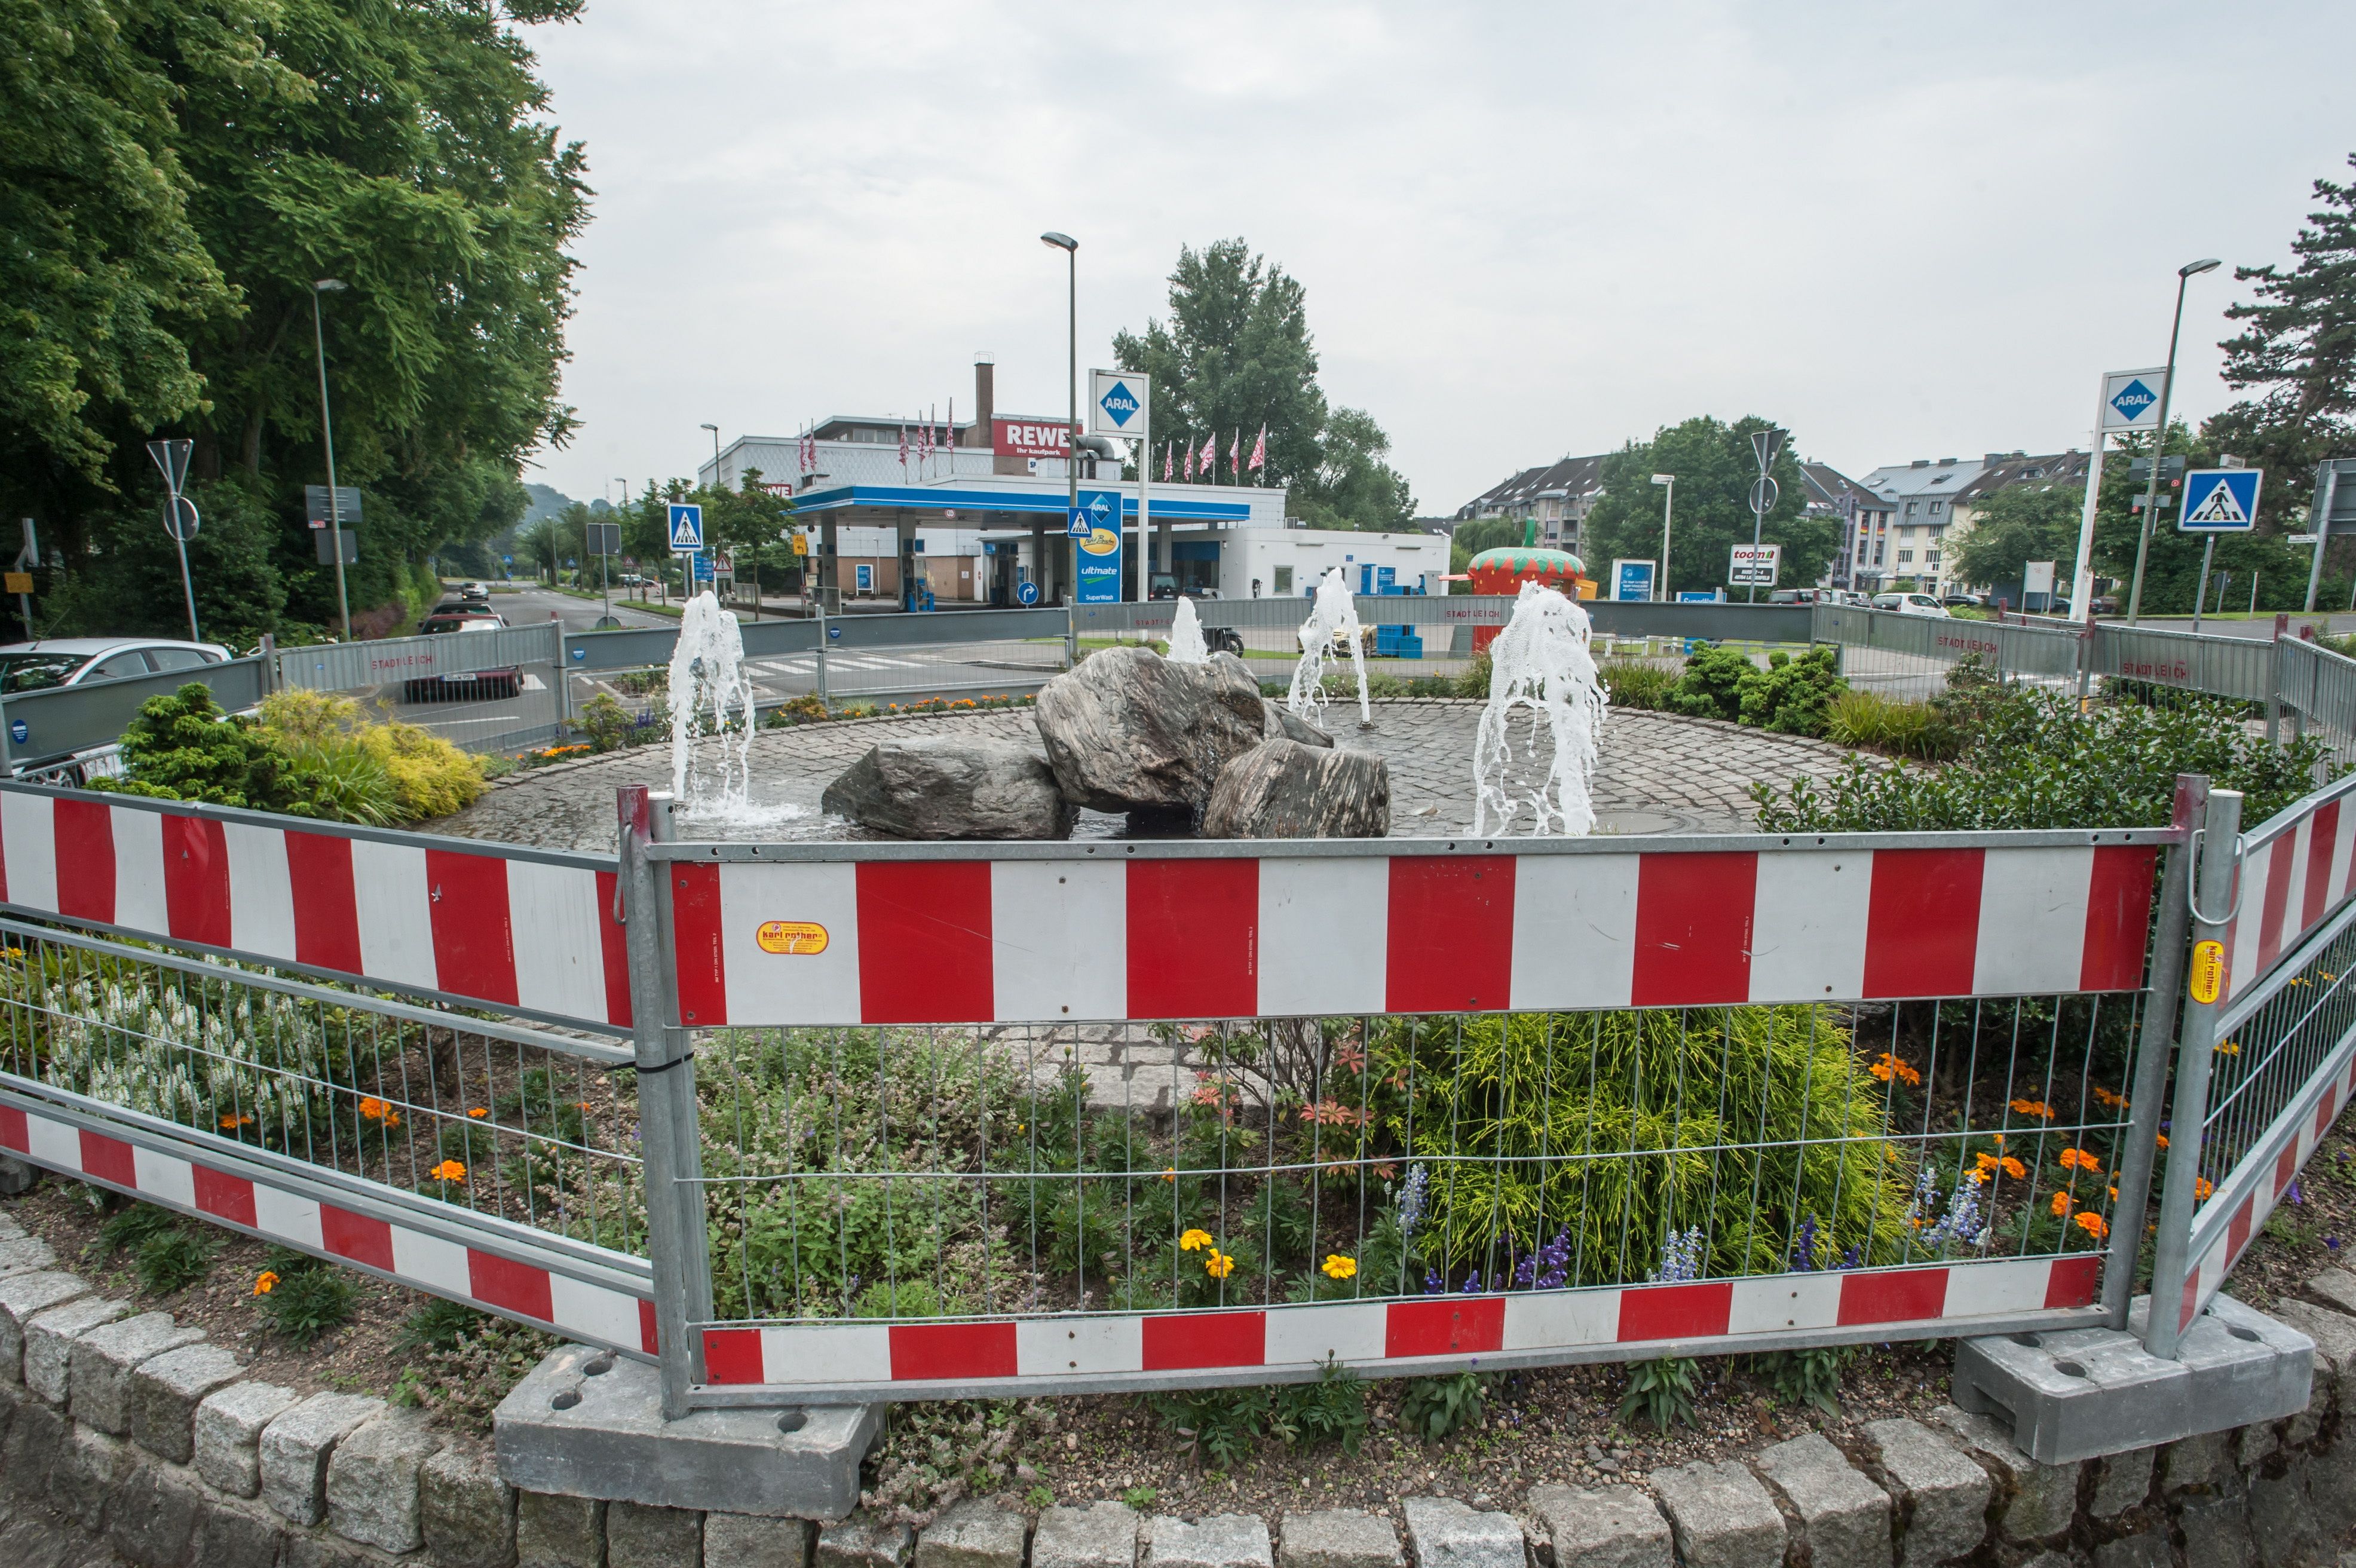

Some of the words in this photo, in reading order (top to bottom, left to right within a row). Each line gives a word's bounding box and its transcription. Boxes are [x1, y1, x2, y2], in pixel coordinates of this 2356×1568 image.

[1104, 397, 1136, 412] ARAL
[2116, 394, 2150, 407] ARAL
[1006, 425, 1070, 448] REWE
[1028, 448, 1061, 456] kaufpark
[1091, 503, 1110, 512] ARAL
[1734, 549, 1765, 559] toom
[1081, 566, 1117, 575] ultimate
[1938, 636, 1965, 648] STADT
[372, 658, 400, 670] STADT
[2208, 946, 2217, 963] karl
[2205, 966, 2214, 995] rother
